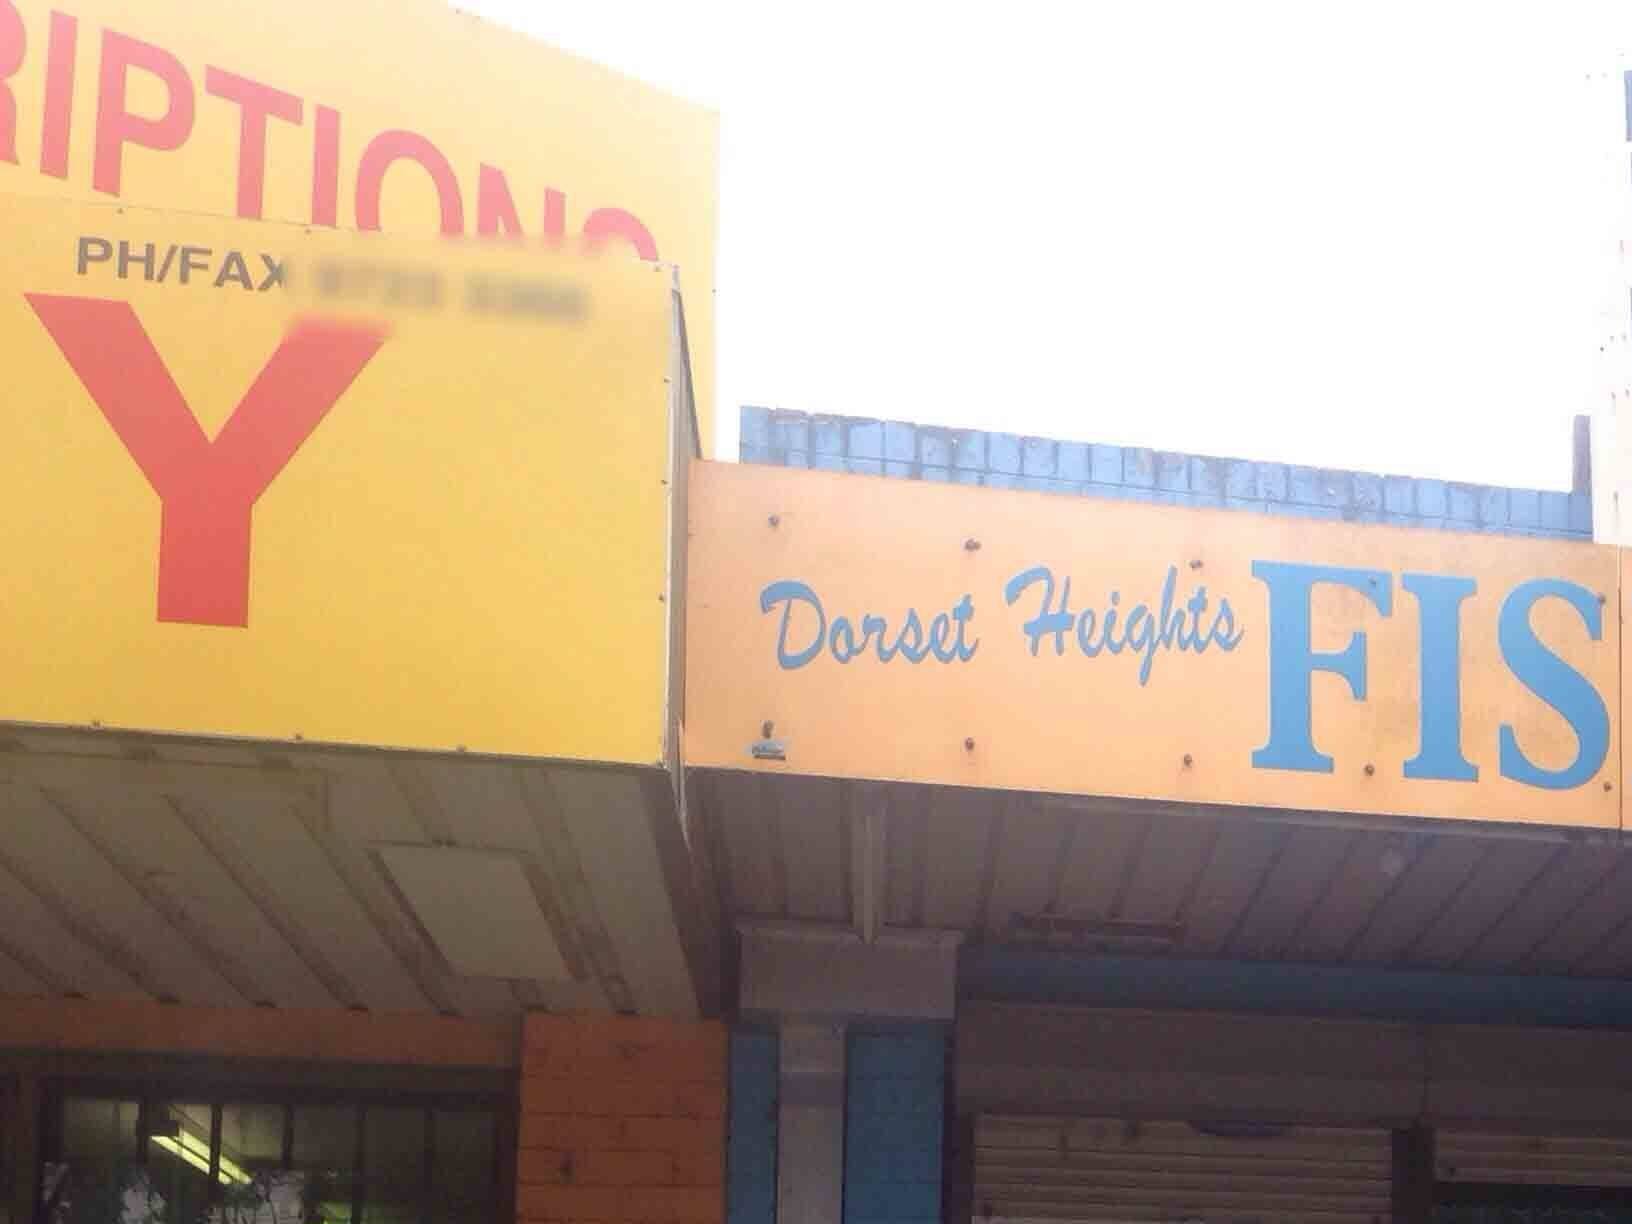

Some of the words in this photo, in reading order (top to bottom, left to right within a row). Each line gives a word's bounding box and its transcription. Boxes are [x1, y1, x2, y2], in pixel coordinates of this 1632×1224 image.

[22, 291, 386, 628] Y
[760, 581, 978, 670] Dorset
[1004, 565, 1245, 687] Heights
